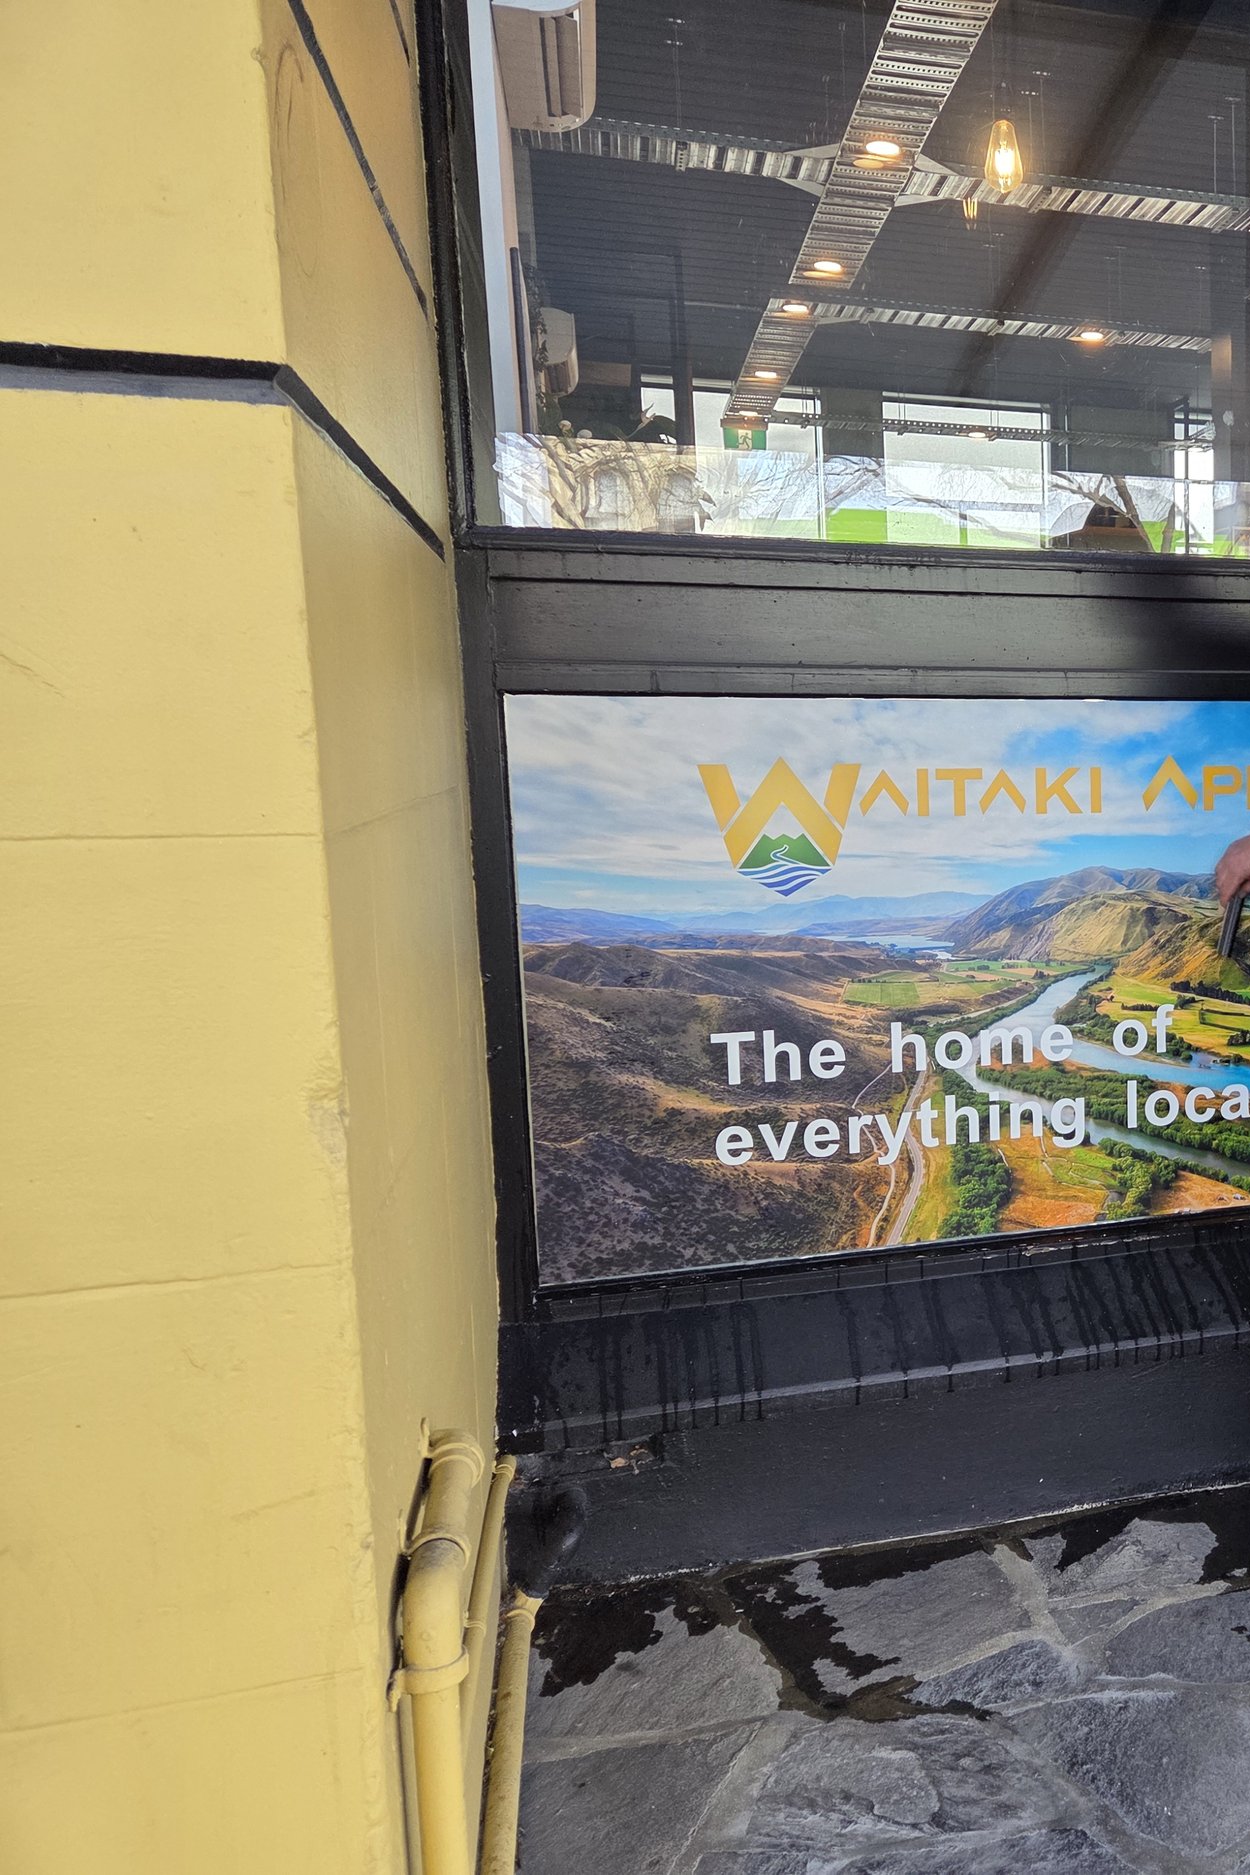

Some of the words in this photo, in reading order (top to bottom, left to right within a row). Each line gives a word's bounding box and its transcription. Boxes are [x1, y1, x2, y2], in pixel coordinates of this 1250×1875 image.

[697, 756, 1102, 869] WAITAKI
[710, 1031, 846, 1085] The
[890, 1022, 1074, 1073] home
[1112, 1004, 1174, 1056] of
[715, 1091, 1085, 1166] everything
